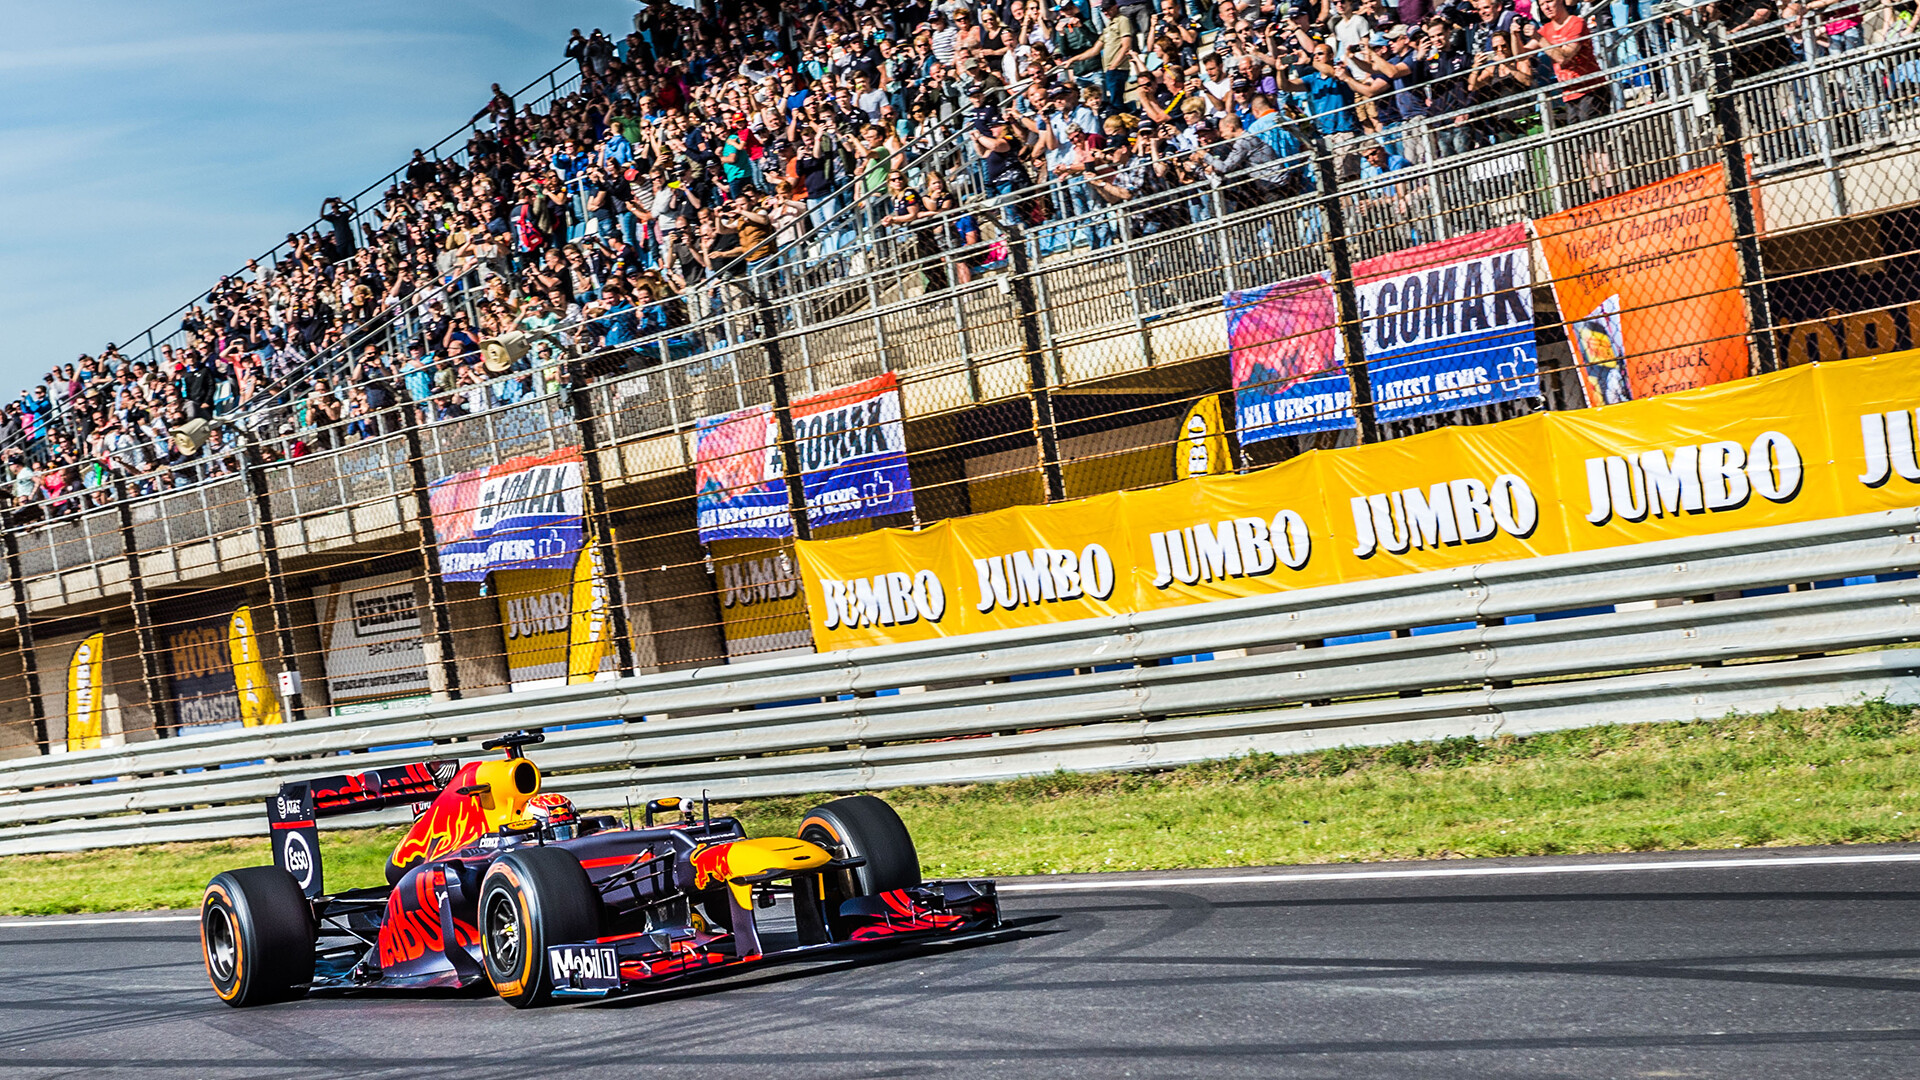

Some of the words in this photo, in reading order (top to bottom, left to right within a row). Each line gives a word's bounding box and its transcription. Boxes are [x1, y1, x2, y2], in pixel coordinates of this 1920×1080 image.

[1566, 224, 1612, 262] World
[1617, 203, 1709, 244] Champion
[1670, 346, 1711, 374] Luck
[1377, 372, 1432, 412] LATEST
[1436, 365, 1492, 401] NEWS
[1584, 430, 1804, 527] JUMBO
[1350, 473, 1539, 560] JUMBO
[1149, 509, 1312, 590] JUMBO
[721, 556, 804, 610] JUMB
[820, 569, 947, 631] JUMBO
[973, 543, 1115, 614] JUMBO
[507, 591, 571, 640] JUMB
[288, 846, 309, 870] Esso
[550, 948, 602, 980] Mobil
